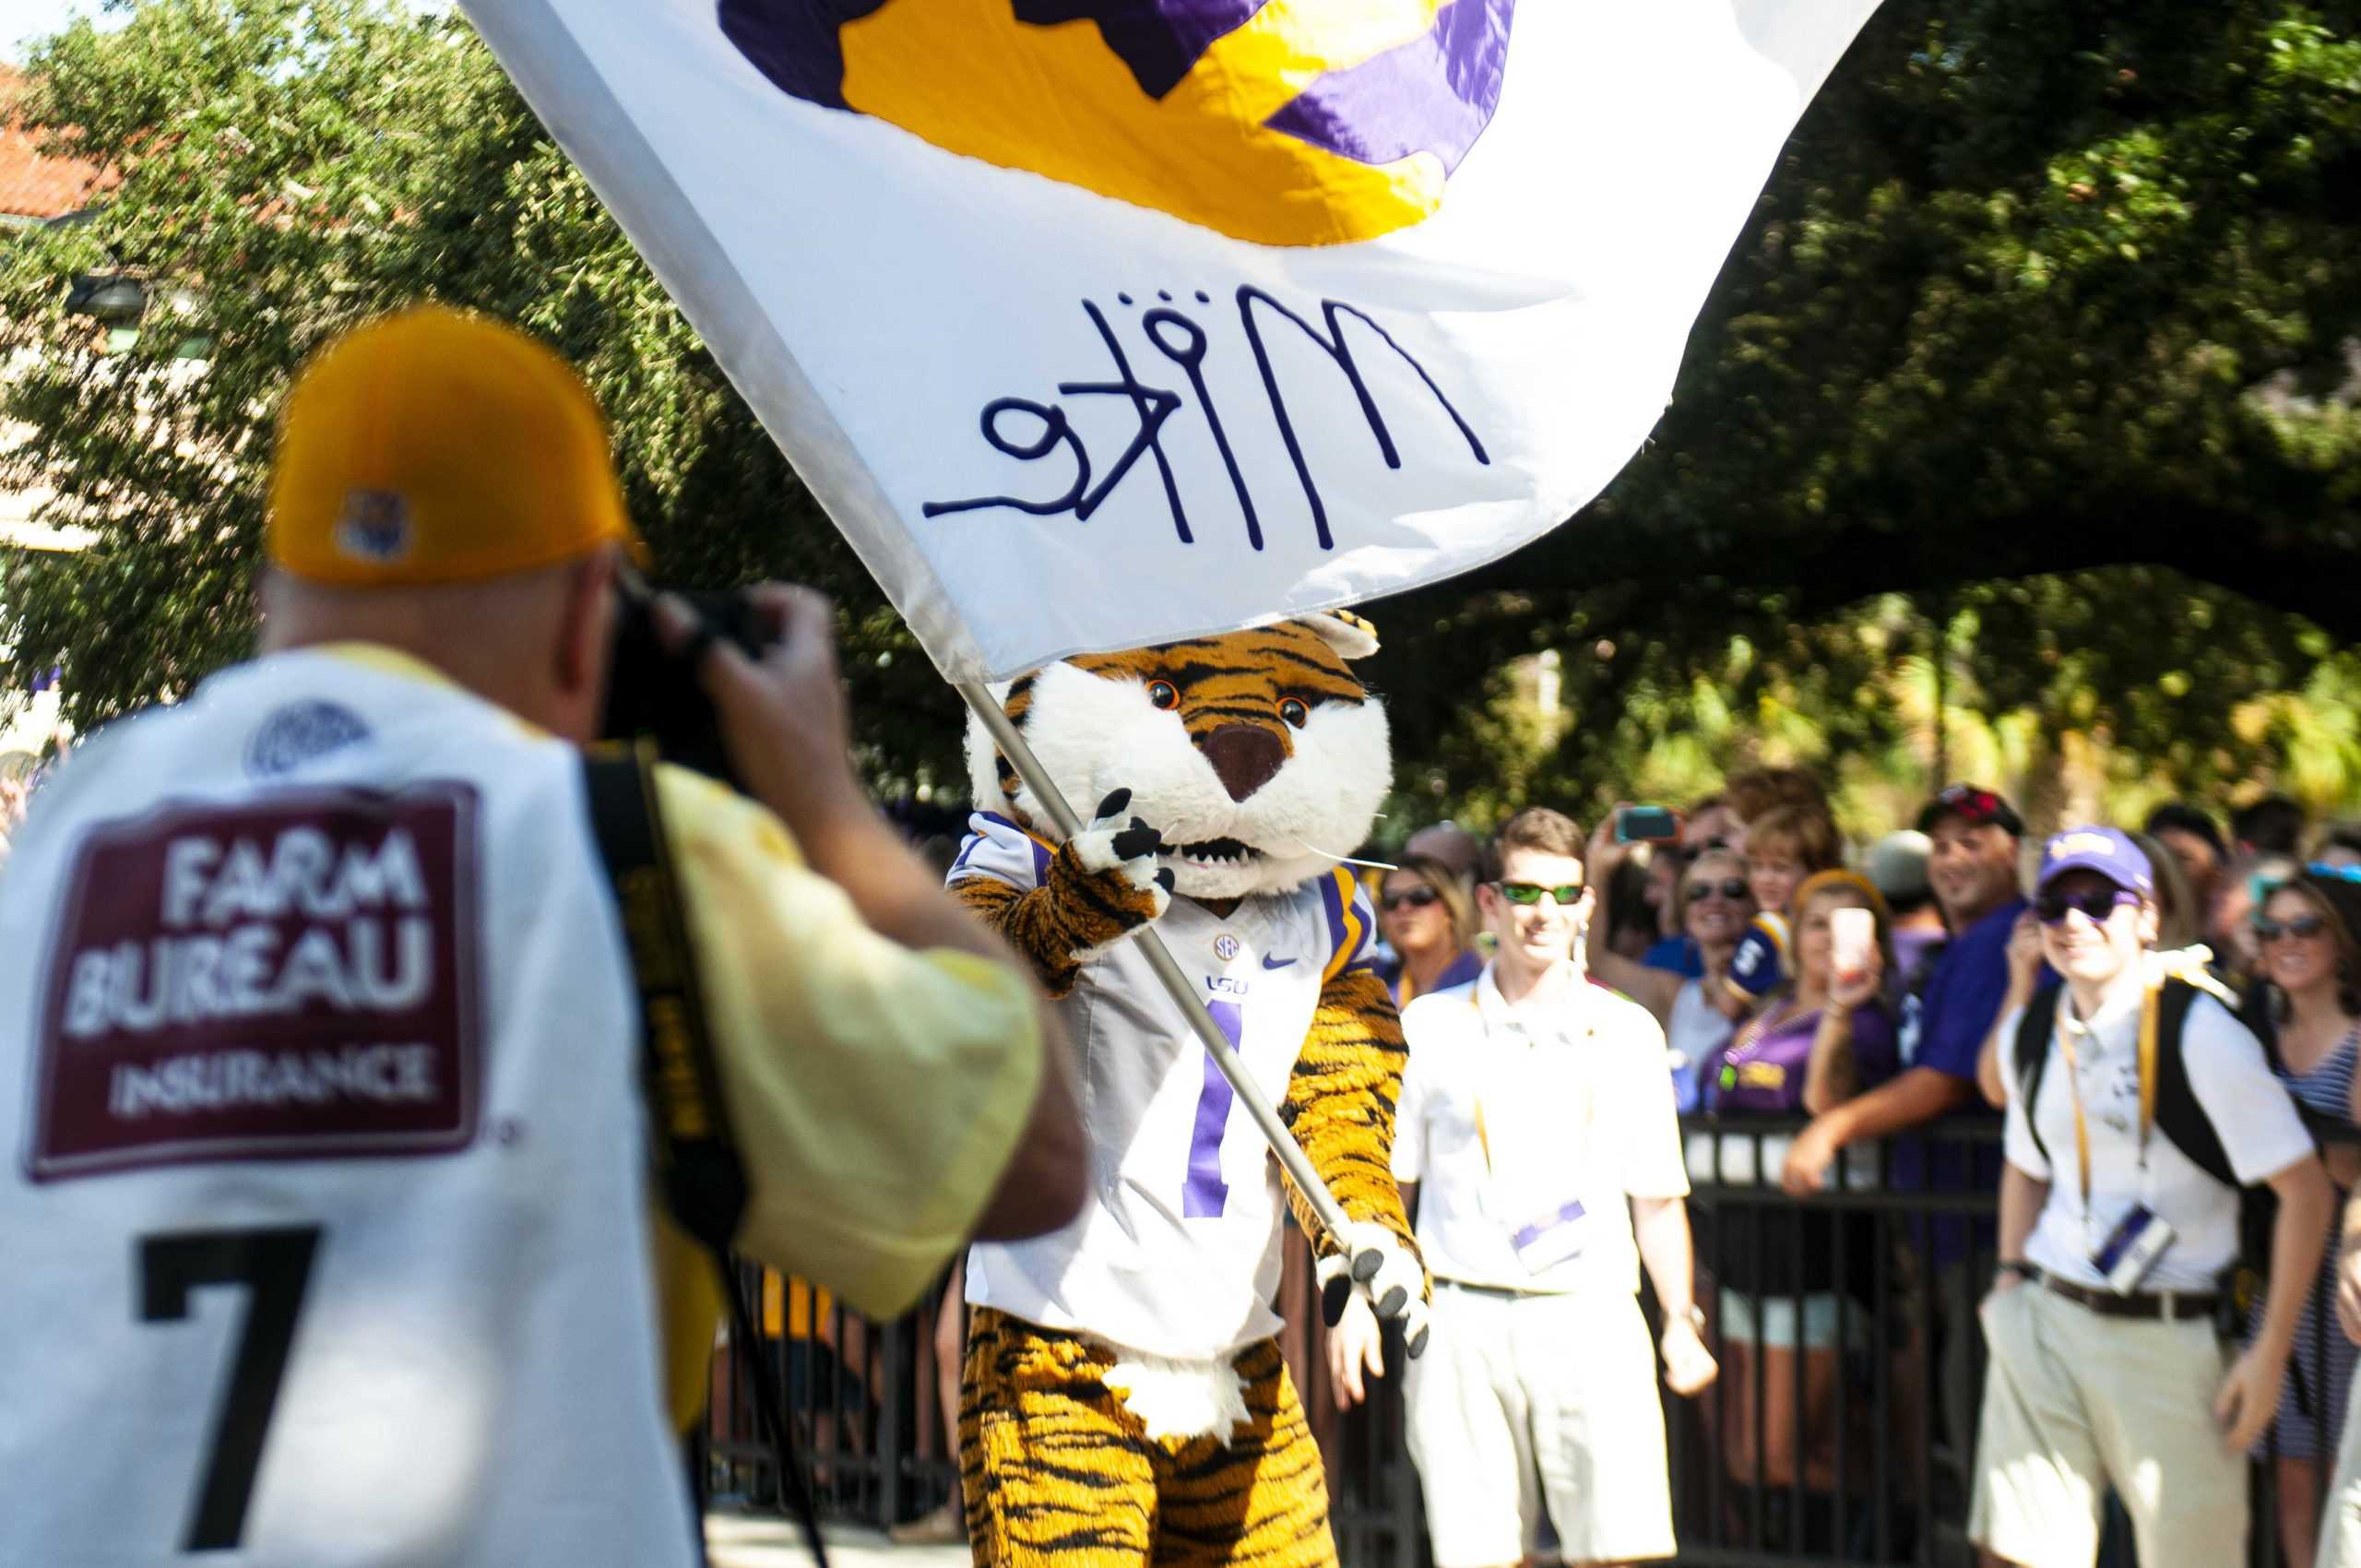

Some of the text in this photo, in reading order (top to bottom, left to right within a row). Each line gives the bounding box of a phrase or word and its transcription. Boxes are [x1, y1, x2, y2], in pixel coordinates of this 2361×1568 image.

[164, 828, 428, 924] FARM
[64, 917, 433, 1037] BUREAU
[1206, 975, 1248, 994] LSU
[111, 1044, 438, 1116] INSURANCE
[135, 1225, 325, 1551] 7
